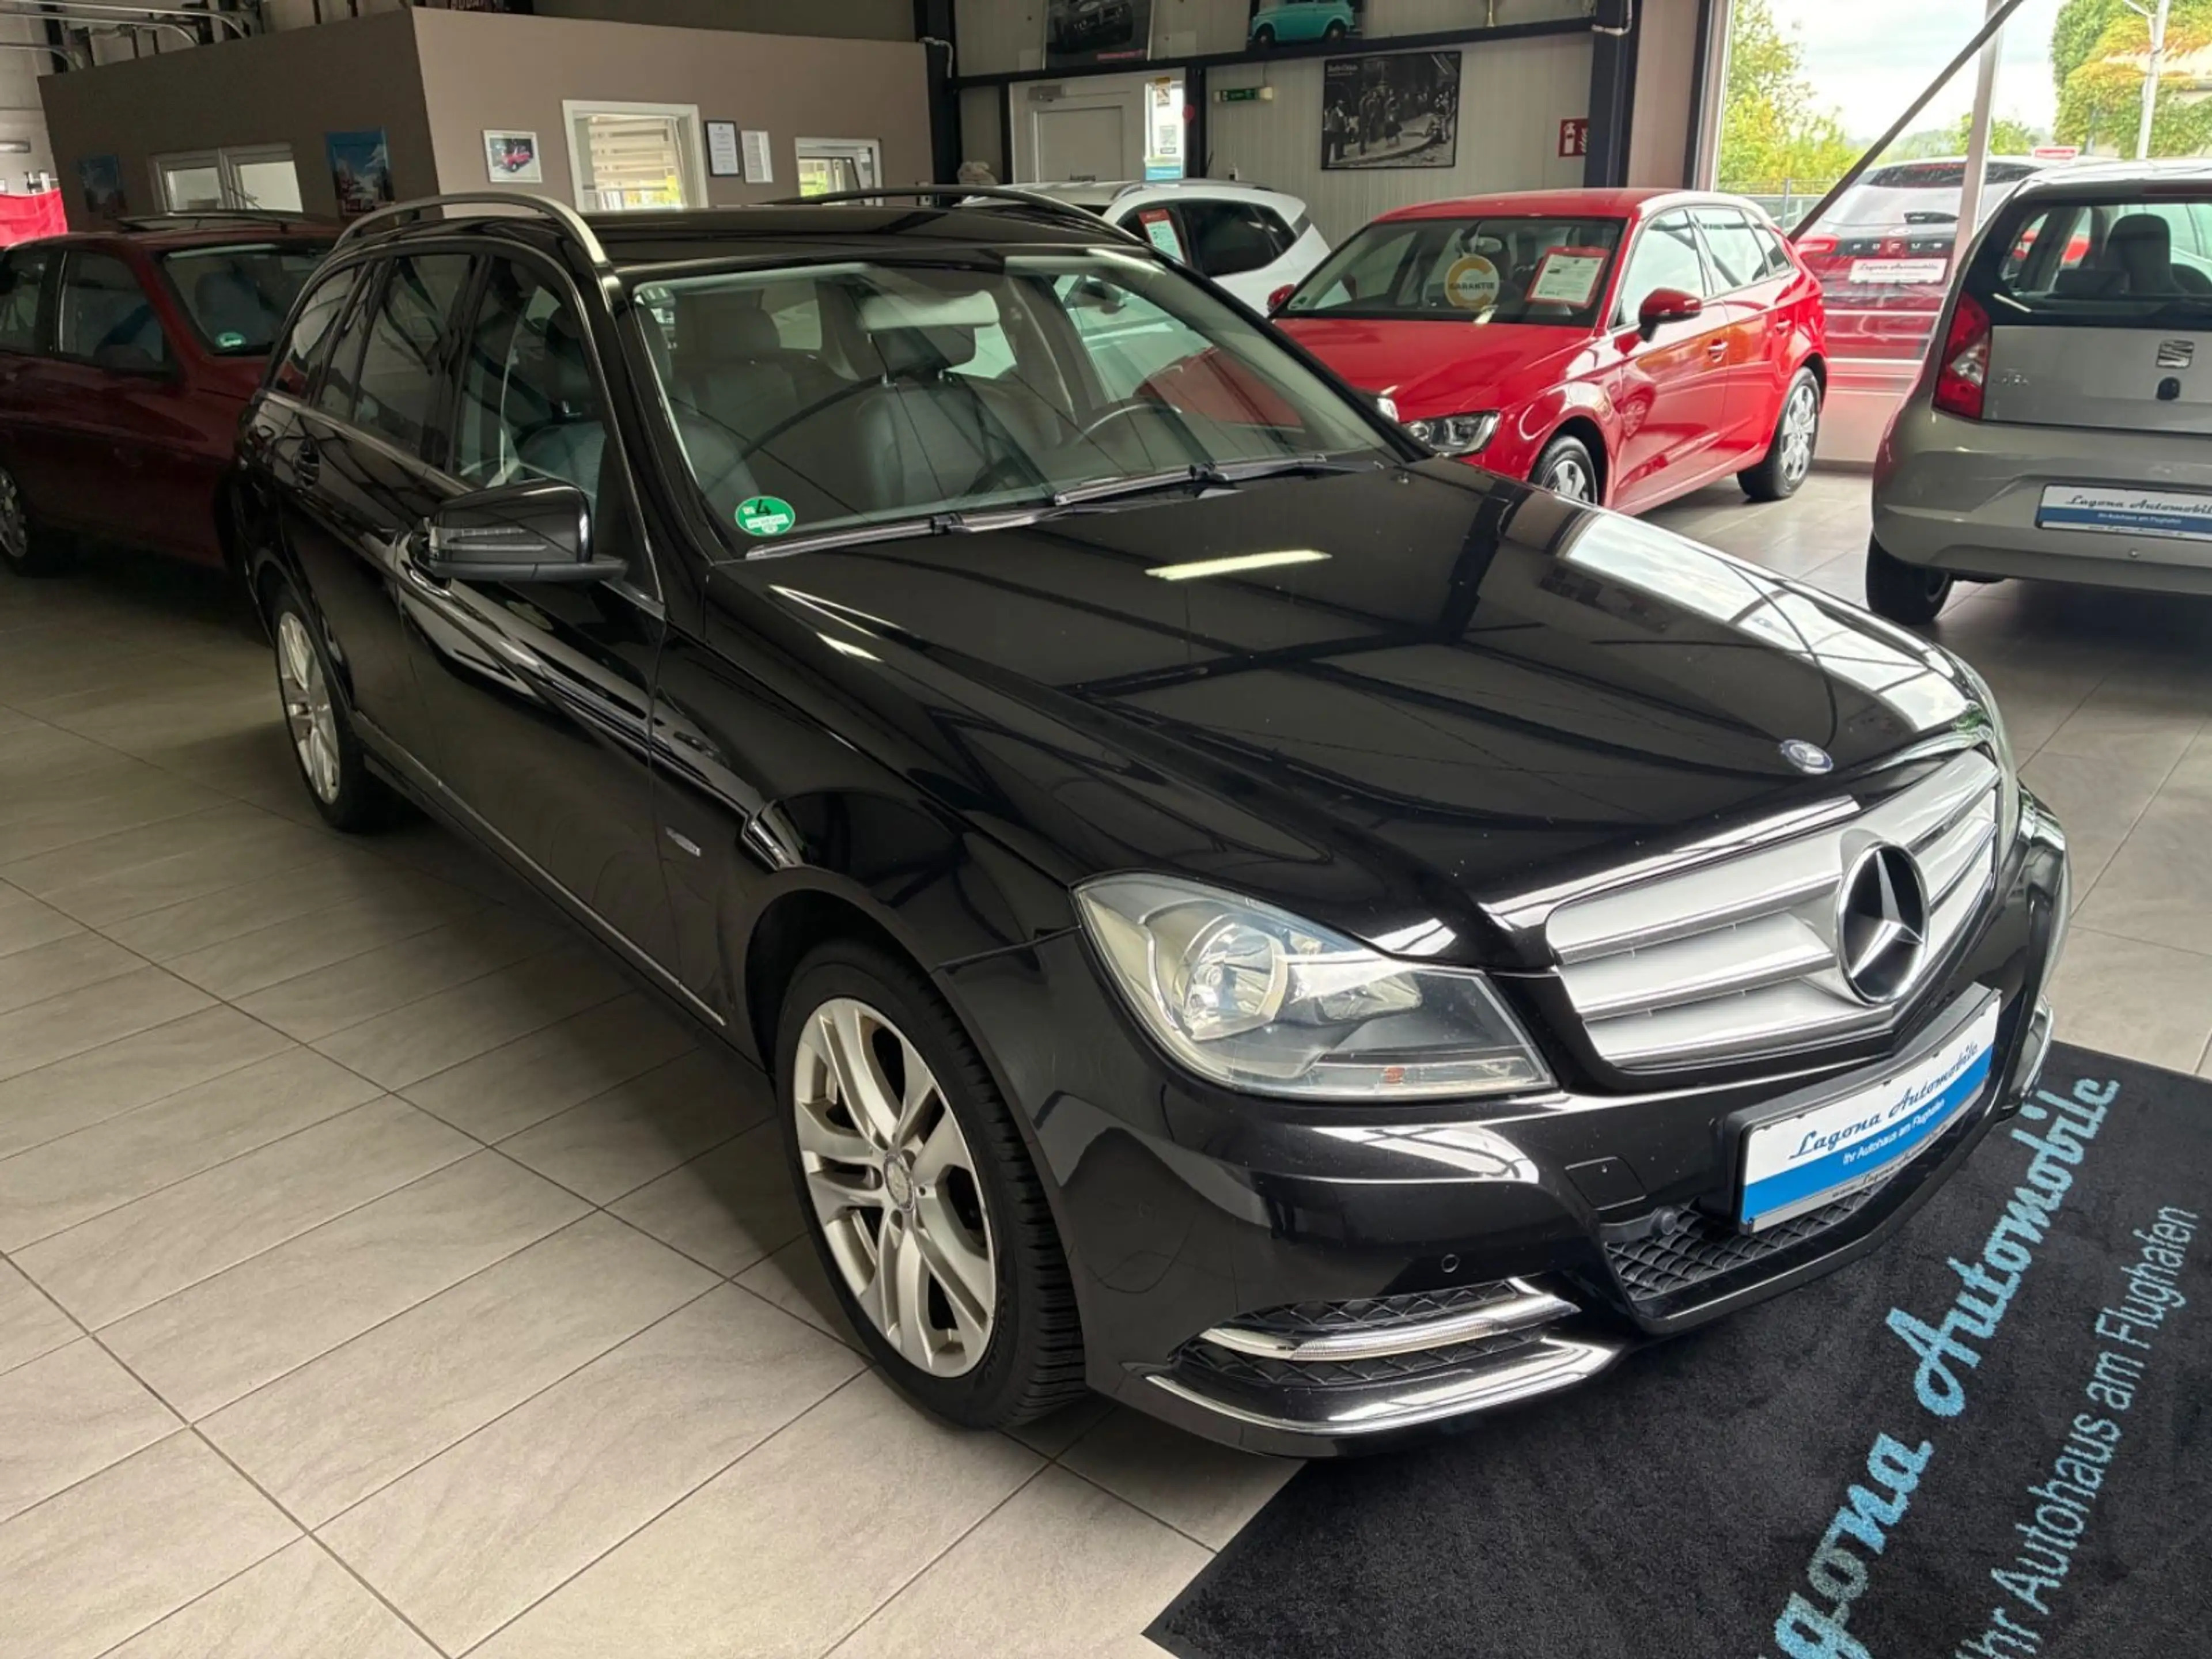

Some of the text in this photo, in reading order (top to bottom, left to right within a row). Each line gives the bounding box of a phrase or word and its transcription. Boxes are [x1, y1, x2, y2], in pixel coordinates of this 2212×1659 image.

[756, 499, 772, 515] 4
[2065, 494, 2124, 507] Lagona
[1789, 1113, 1882, 1160] Lagona
[1888, 1043, 1978, 1118] Automobile
[1843, 1152, 1857, 1165] Ihr
[1857, 1130, 1898, 1159] Autohaus
[1899, 1123, 1911, 1137] am
[2095, 1206, 2198, 1350] Flughafen
[1758, 1078, 2121, 1659] gona Automobile
[2086, 1351, 2144, 1411] am
[1992, 1414, 2122, 1615] Autohaus
